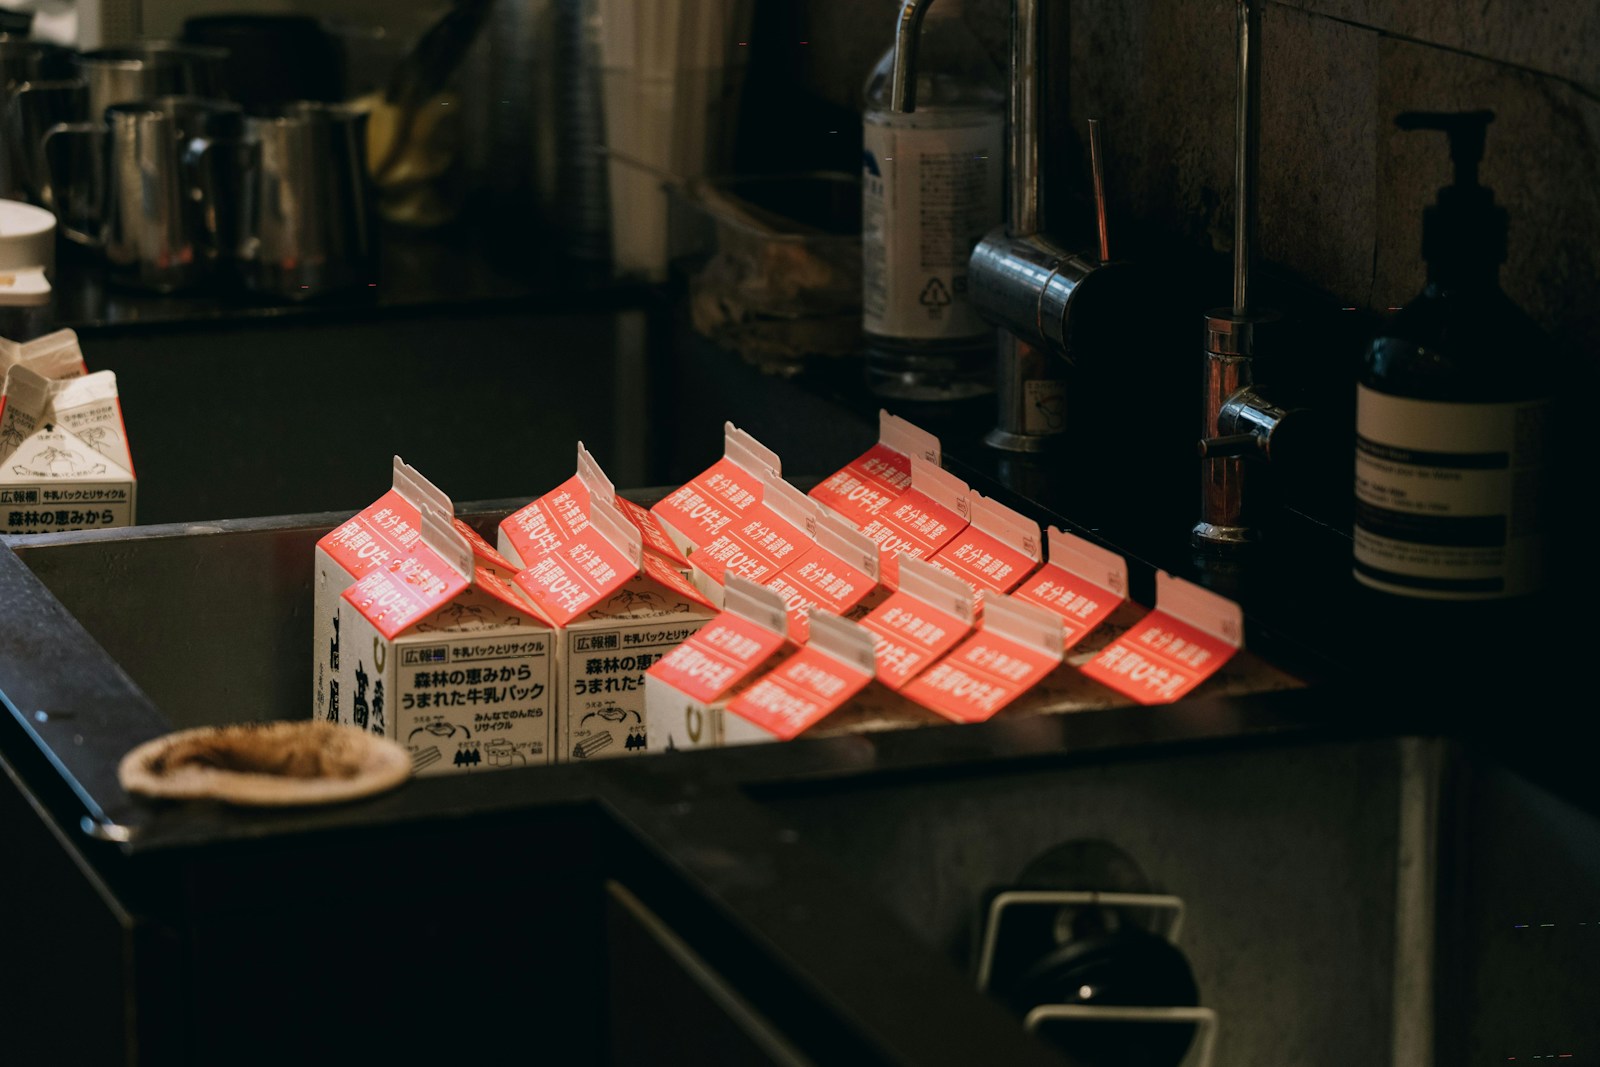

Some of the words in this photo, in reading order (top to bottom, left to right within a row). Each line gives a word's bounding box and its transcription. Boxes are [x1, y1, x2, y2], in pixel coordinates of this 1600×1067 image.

[1, 490, 38, 503] 広報欄
[44, 489, 126, 501] 牛乳パックとリサイクル
[705, 473, 756, 510] 成分無調整
[8, 509, 114, 526] 森林の恵みから
[372, 508, 421, 548] 成分無調
[892, 504, 947, 541] 成分無調整
[741, 521, 795, 559] 成分無調整
[569, 544, 616, 585] 成分無調整
[953, 544, 1014, 581] 成分無調整
[797, 561, 855, 601] 成分無調整
[1032, 581, 1099, 620] 成分無調整
[624, 629, 701, 644] 牛乳パックとリサイ
[880, 607, 947, 644] 成分無調整
[453, 642, 544, 658] 牛乳パックとリサイクル
[577, 635, 617, 650] 広報欄
[405, 649, 446, 663] 広報欄
[414, 664, 532, 689] 森林の恵みから
[402, 683, 545, 710] うまれた牛乳パック
[474, 708, 544, 722] みんなでのんだら
[474, 722, 513, 733] リサイクル
[573, 729, 592, 737] つかう
